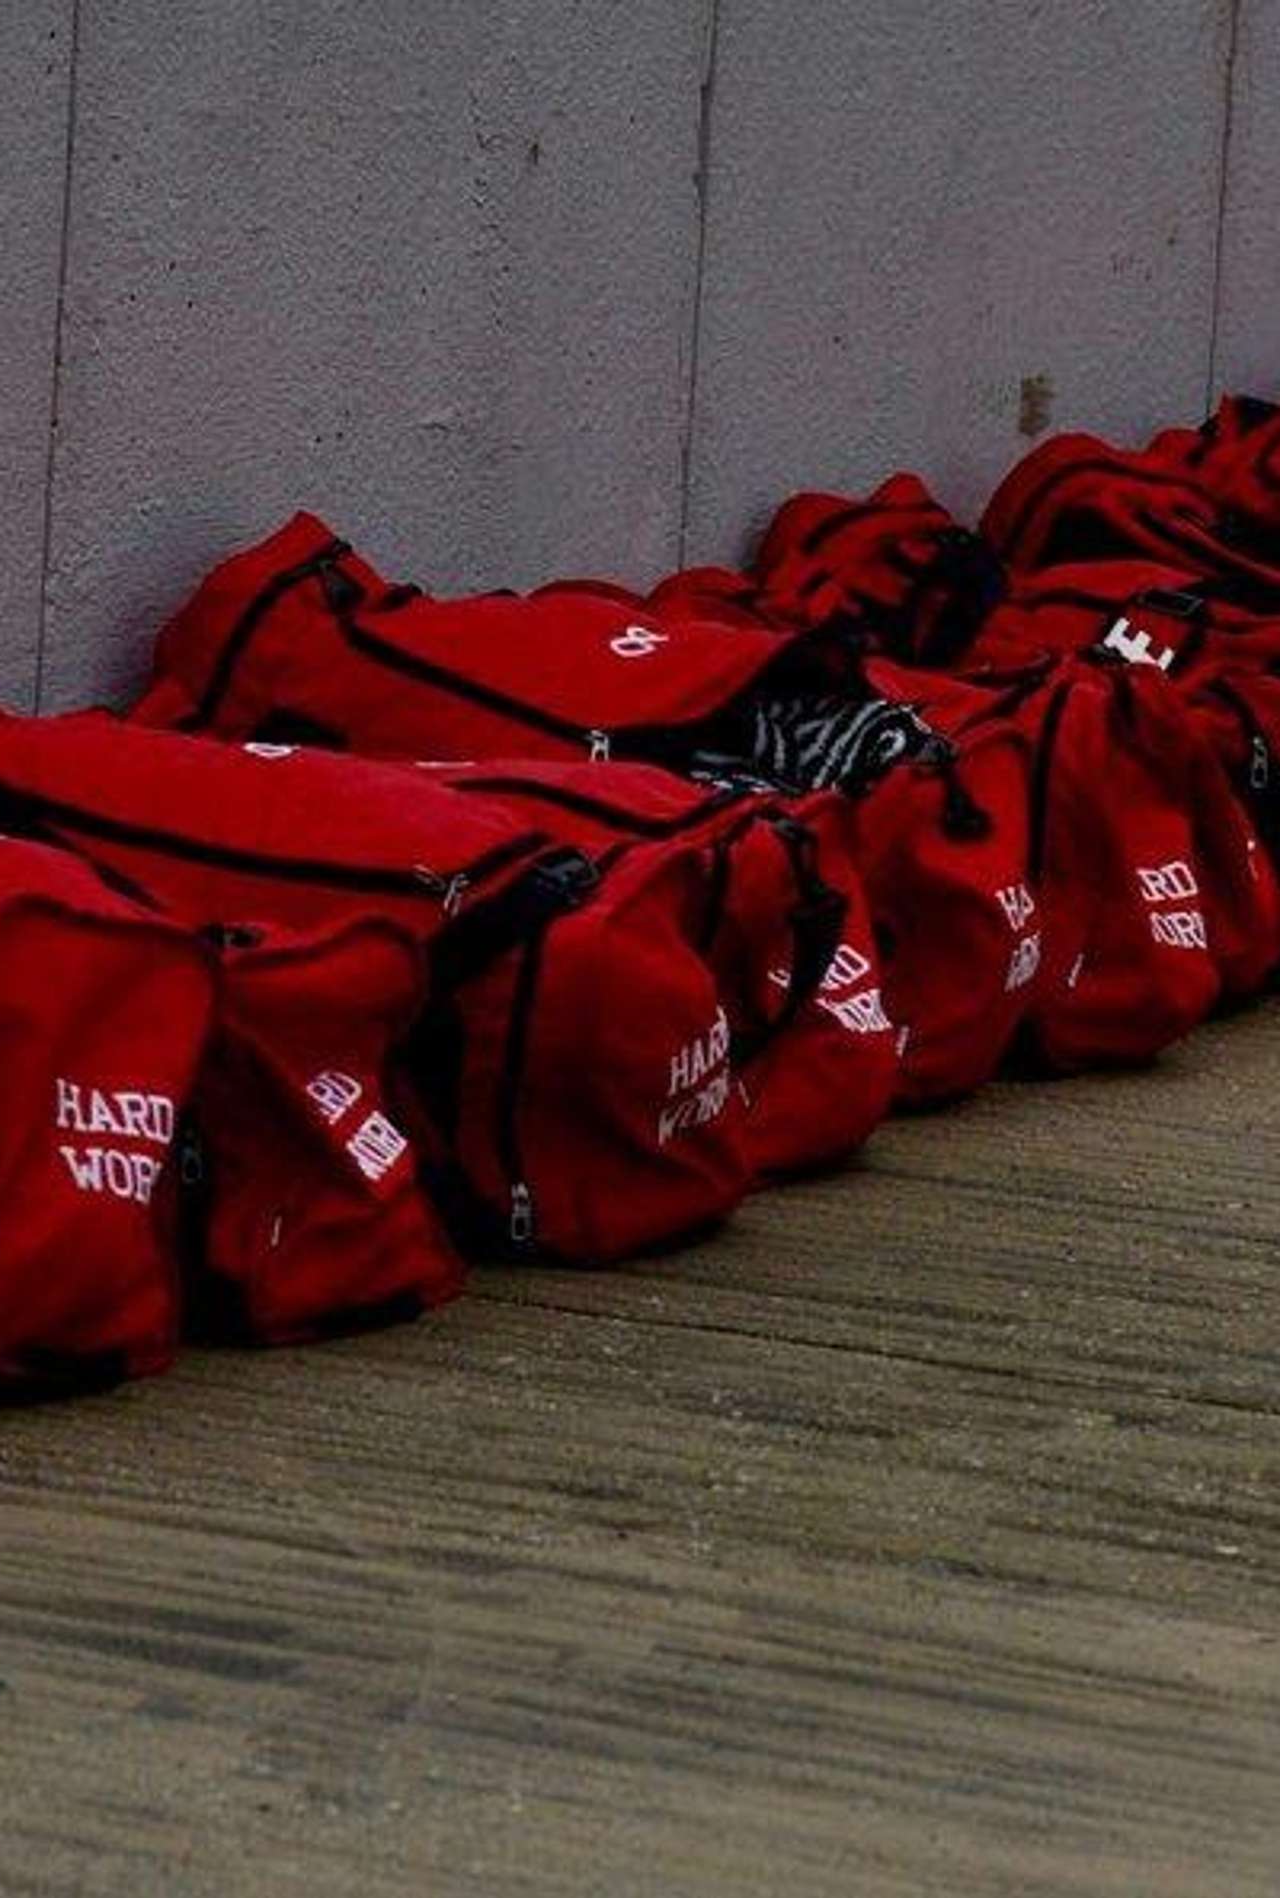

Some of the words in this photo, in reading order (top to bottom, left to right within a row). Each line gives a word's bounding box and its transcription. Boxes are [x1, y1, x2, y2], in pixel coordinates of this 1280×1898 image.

[1136, 860, 1199, 902] RD
[668, 1005, 730, 1096] HAR
[56, 1078, 174, 1144] HARD
[306, 1072, 363, 1126] RD
[59, 1145, 162, 1204] WOR
